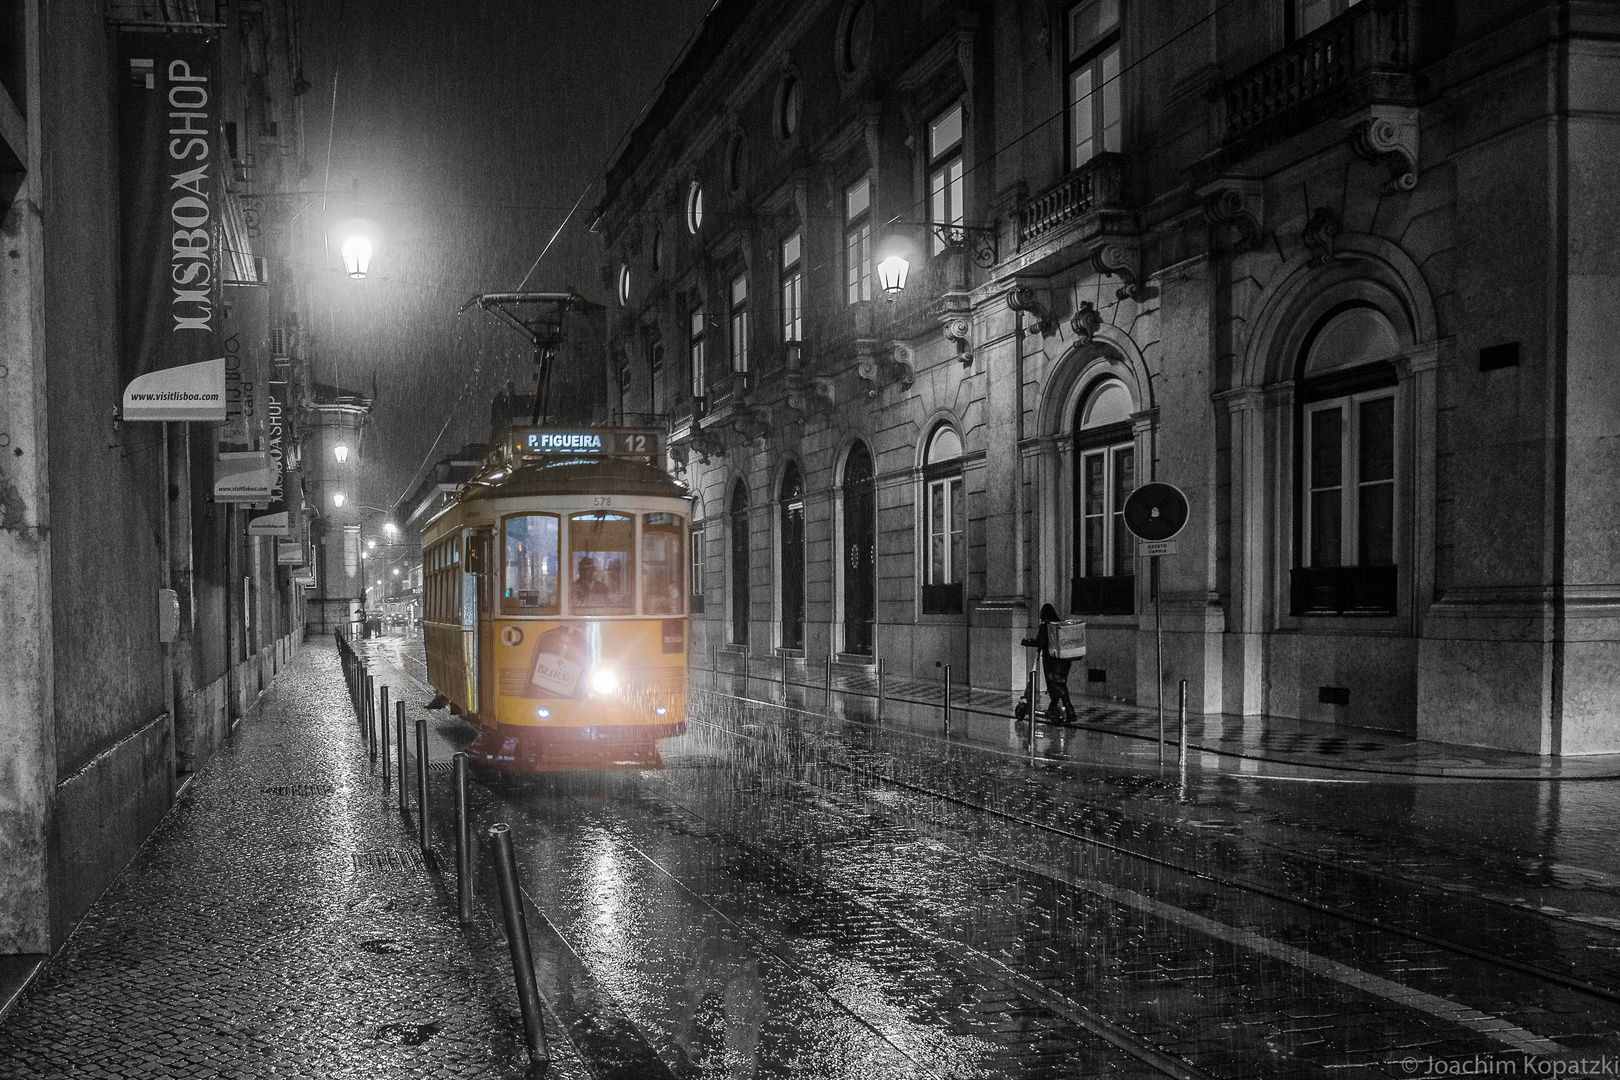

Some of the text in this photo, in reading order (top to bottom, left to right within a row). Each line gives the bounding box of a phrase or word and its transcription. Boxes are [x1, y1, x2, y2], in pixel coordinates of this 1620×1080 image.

[168, 59, 212, 333] LISBOA SHOP
[130, 391, 220, 402] www.visitlisboa.com
[240, 381, 254, 417] card
[527, 434, 602, 448] P. FIGUEIRA
[625, 434, 647, 452] 12
[593, 497, 612, 507] 578
